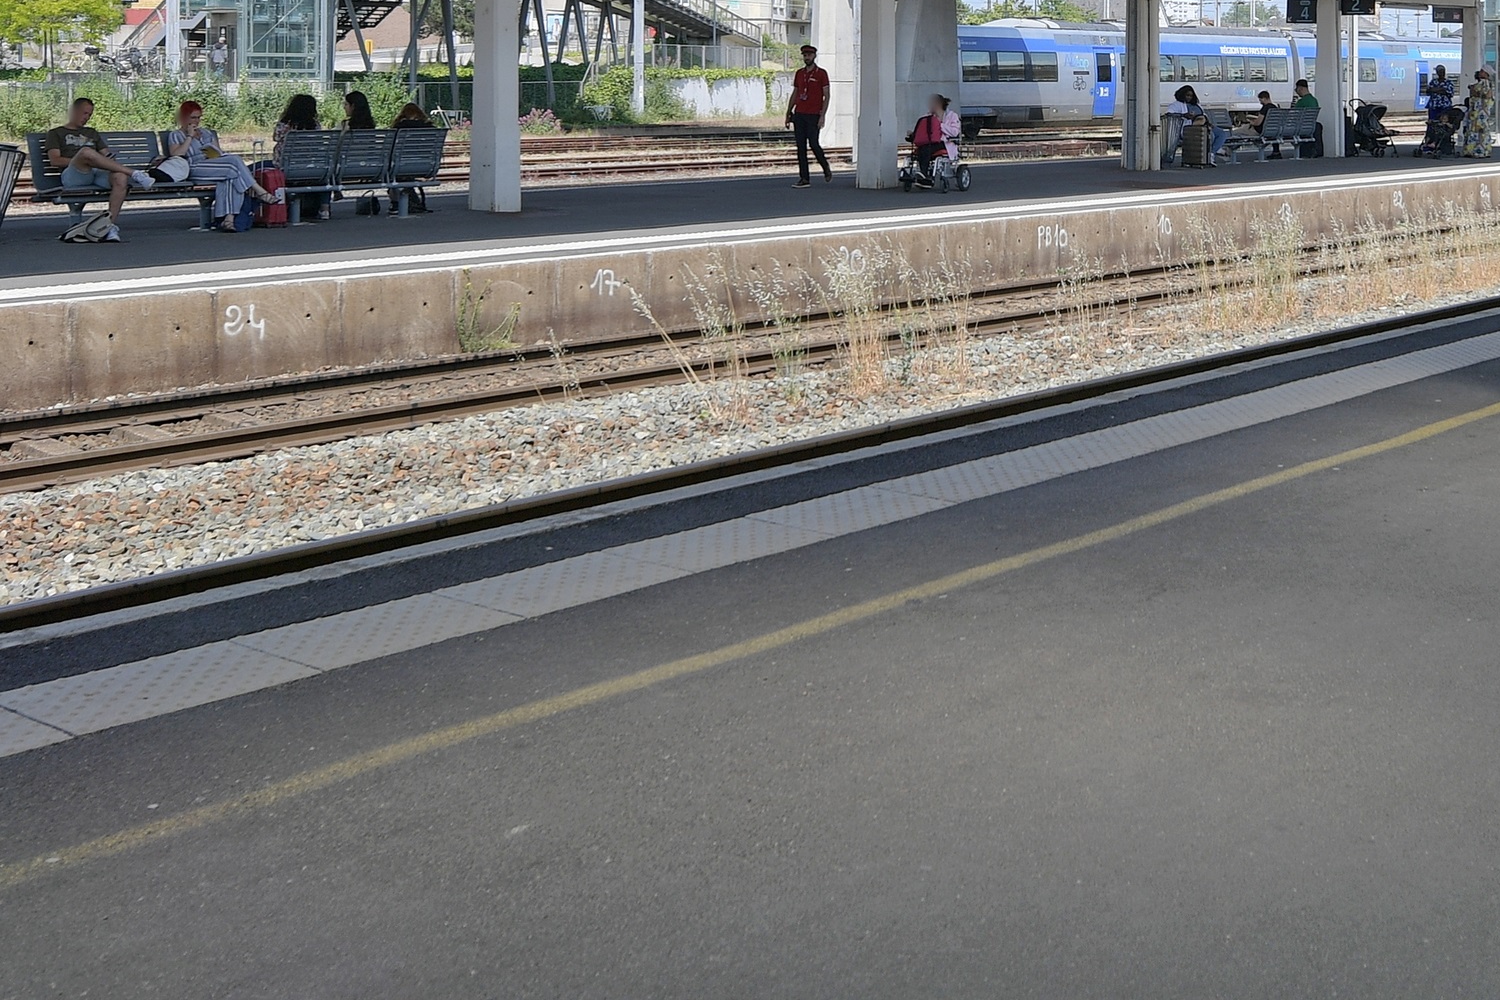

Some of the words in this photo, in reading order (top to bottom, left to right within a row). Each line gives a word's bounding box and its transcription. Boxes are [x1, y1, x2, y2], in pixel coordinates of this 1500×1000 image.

[1300, 6, 1310, 20] 4
[1037, 223, 1068, 250] PB10
[1157, 214, 1172, 235] 10
[590, 268, 621, 296] 17
[224, 304, 265, 340] 24
